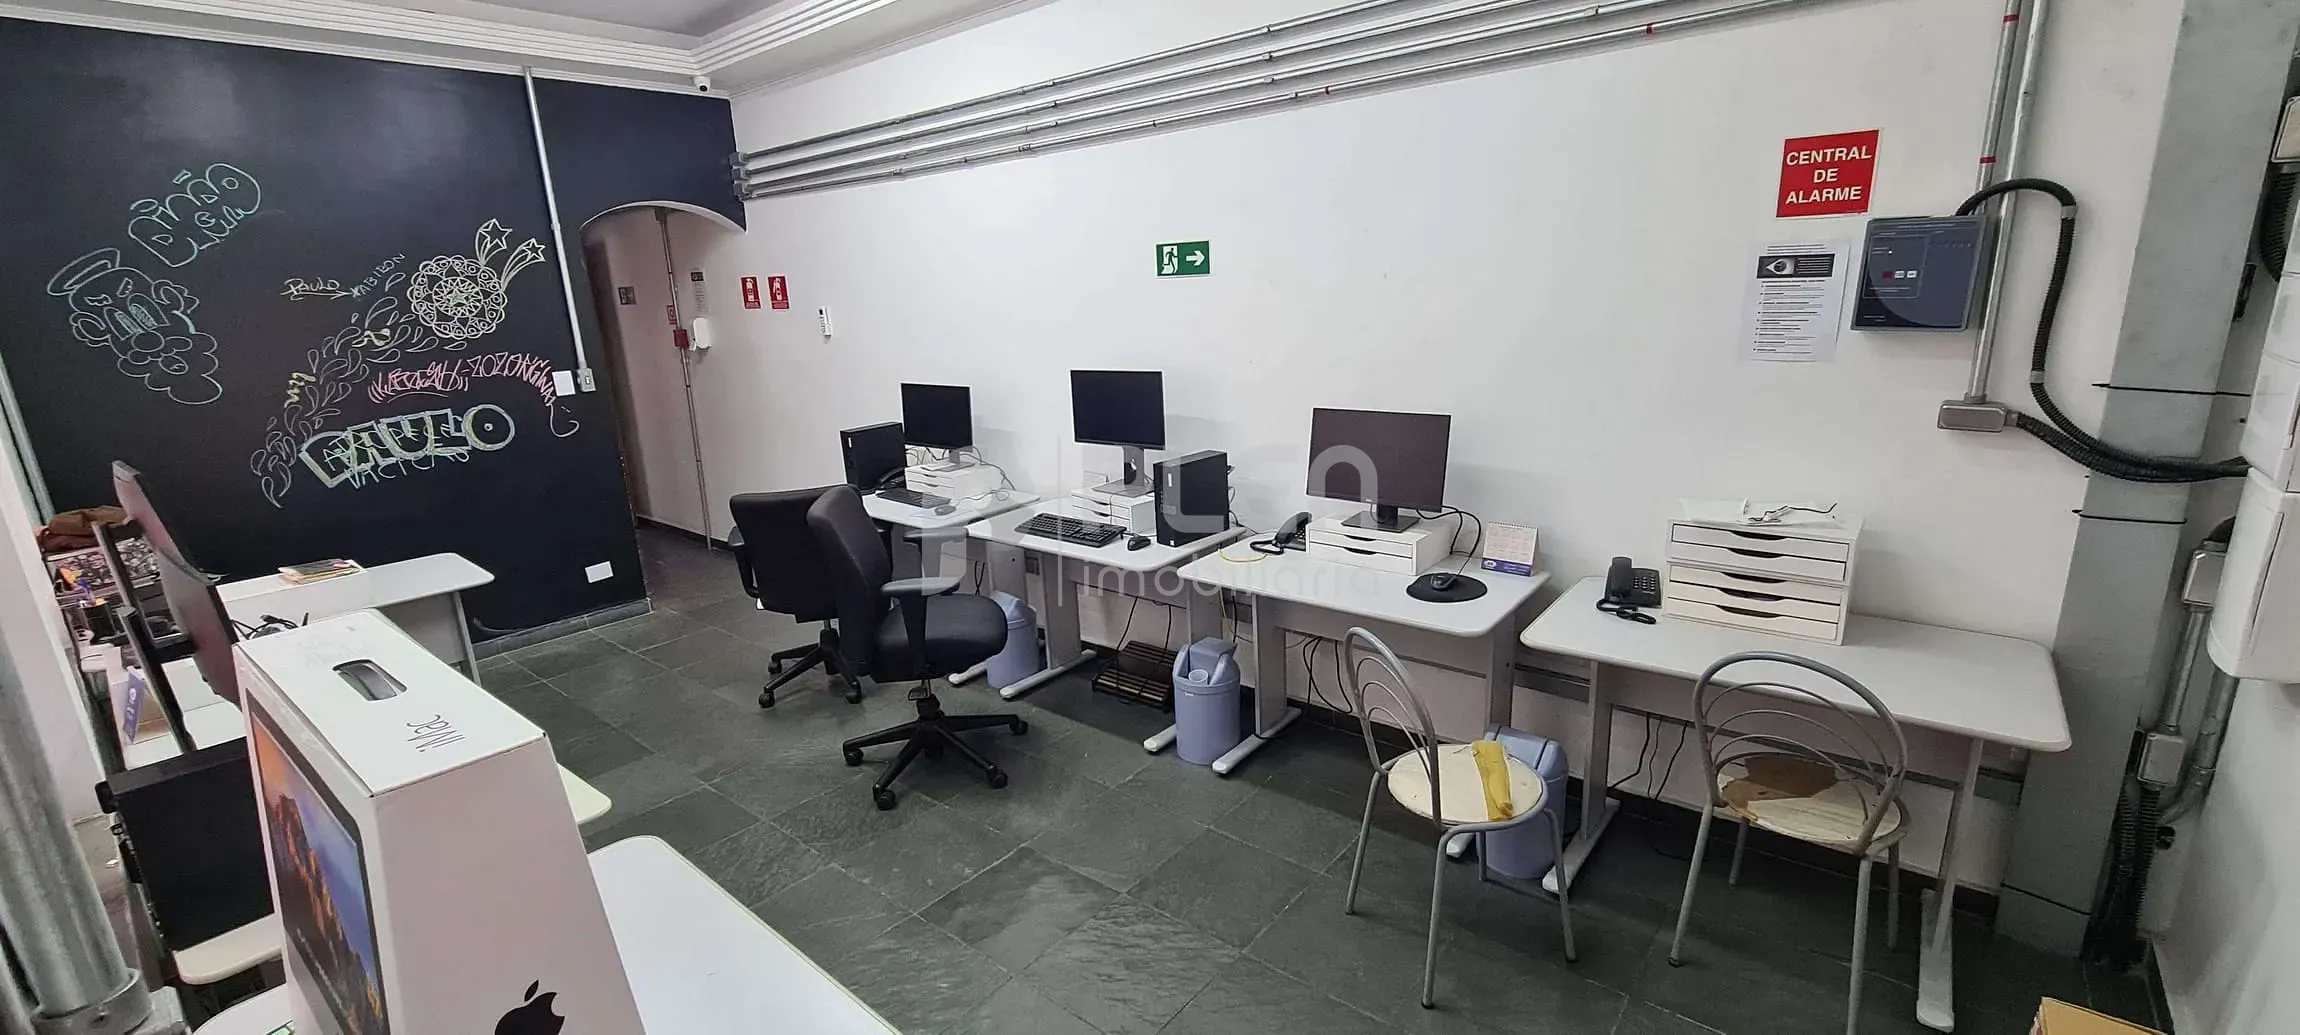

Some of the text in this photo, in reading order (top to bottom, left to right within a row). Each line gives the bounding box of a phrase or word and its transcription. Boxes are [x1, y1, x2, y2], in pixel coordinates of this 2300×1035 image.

[1786, 145, 1872, 166] CENTRAL
[1813, 168, 1839, 184] DE
[1785, 186, 1862, 205] ALARME
